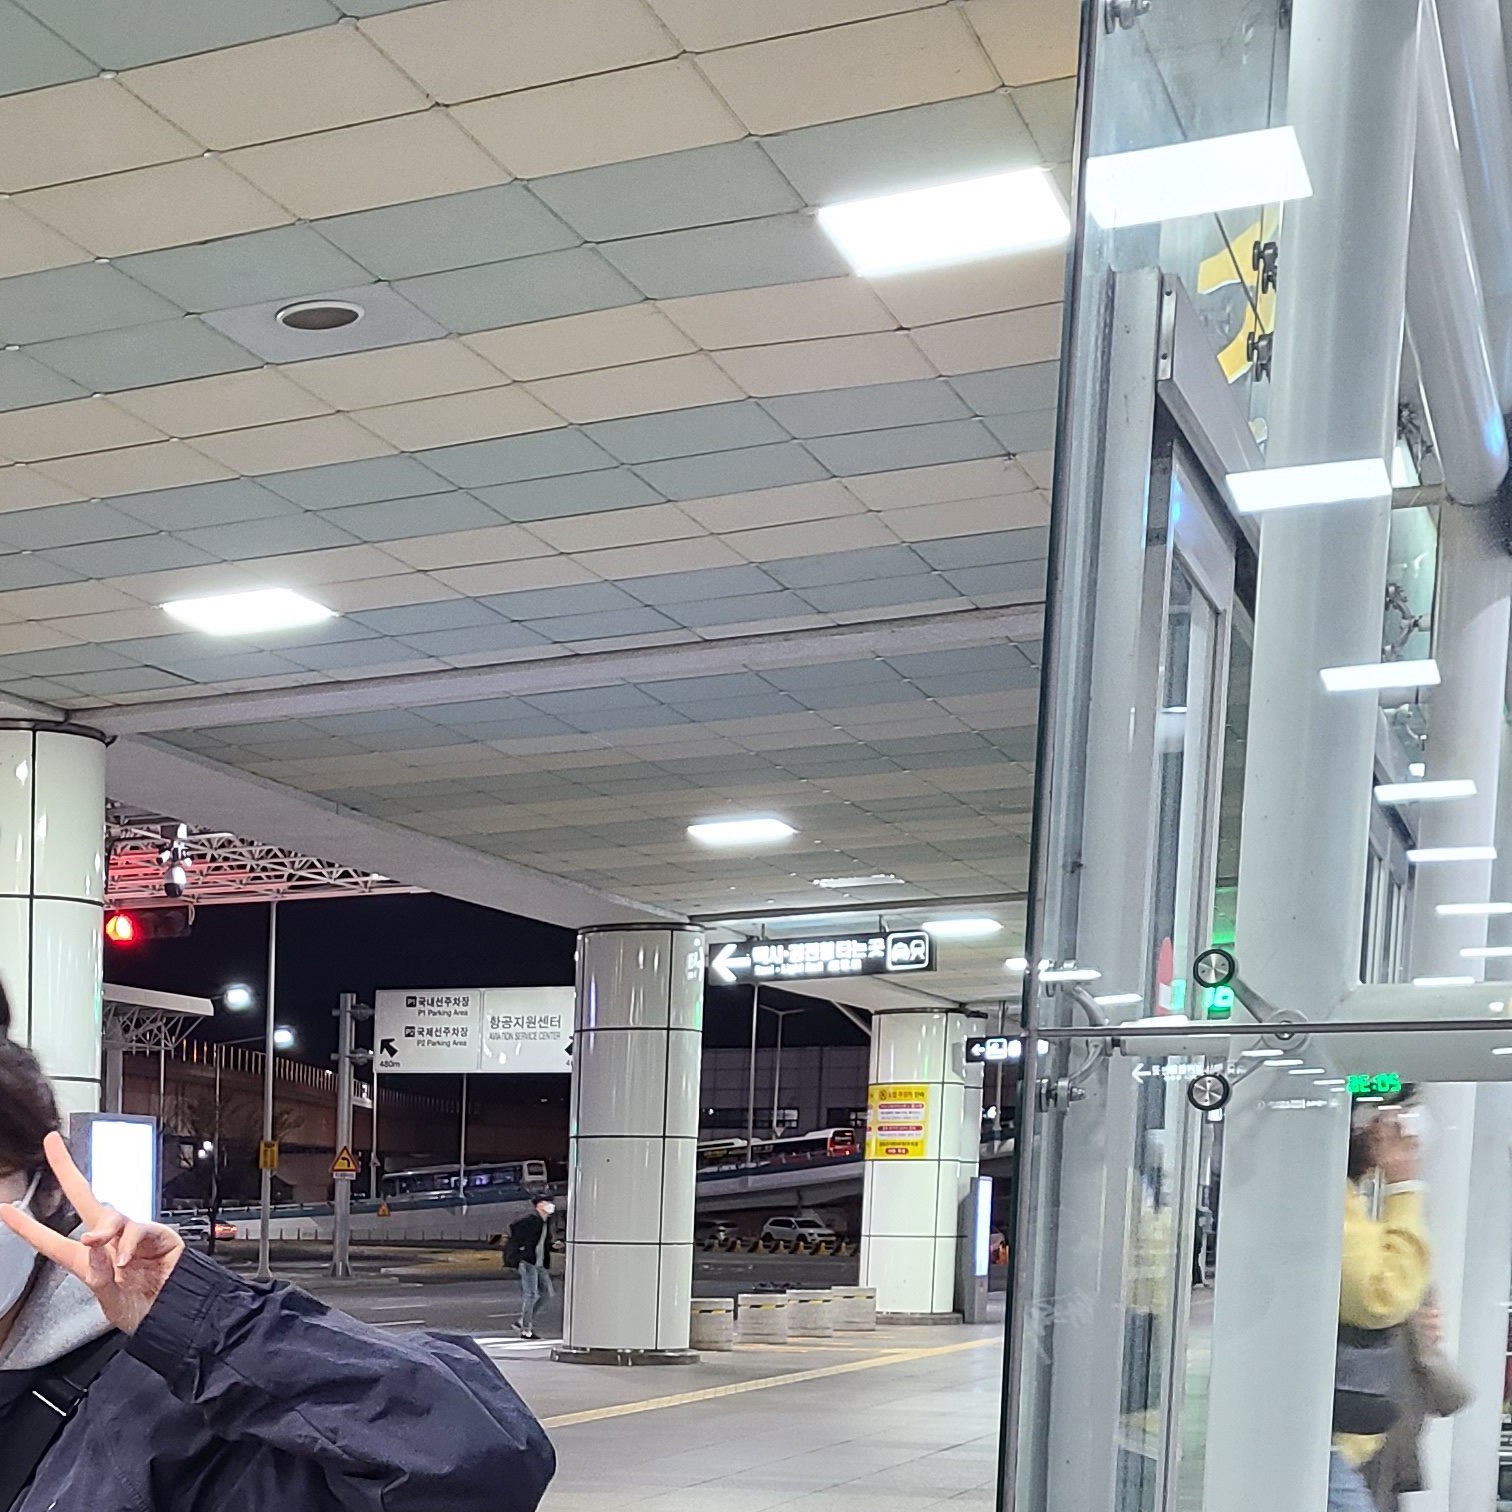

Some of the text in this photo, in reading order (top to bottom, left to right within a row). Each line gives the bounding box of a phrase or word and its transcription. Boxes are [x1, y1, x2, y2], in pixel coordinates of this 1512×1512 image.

[418, 996, 470, 1007] 국내선주차장
[428, 1009, 452, 1017] Parking
[490, 1014, 562, 1029] 항공지원센터
[417, 1027, 468, 1037] 국제선주차장
[427, 1039, 451, 1048] Parking
